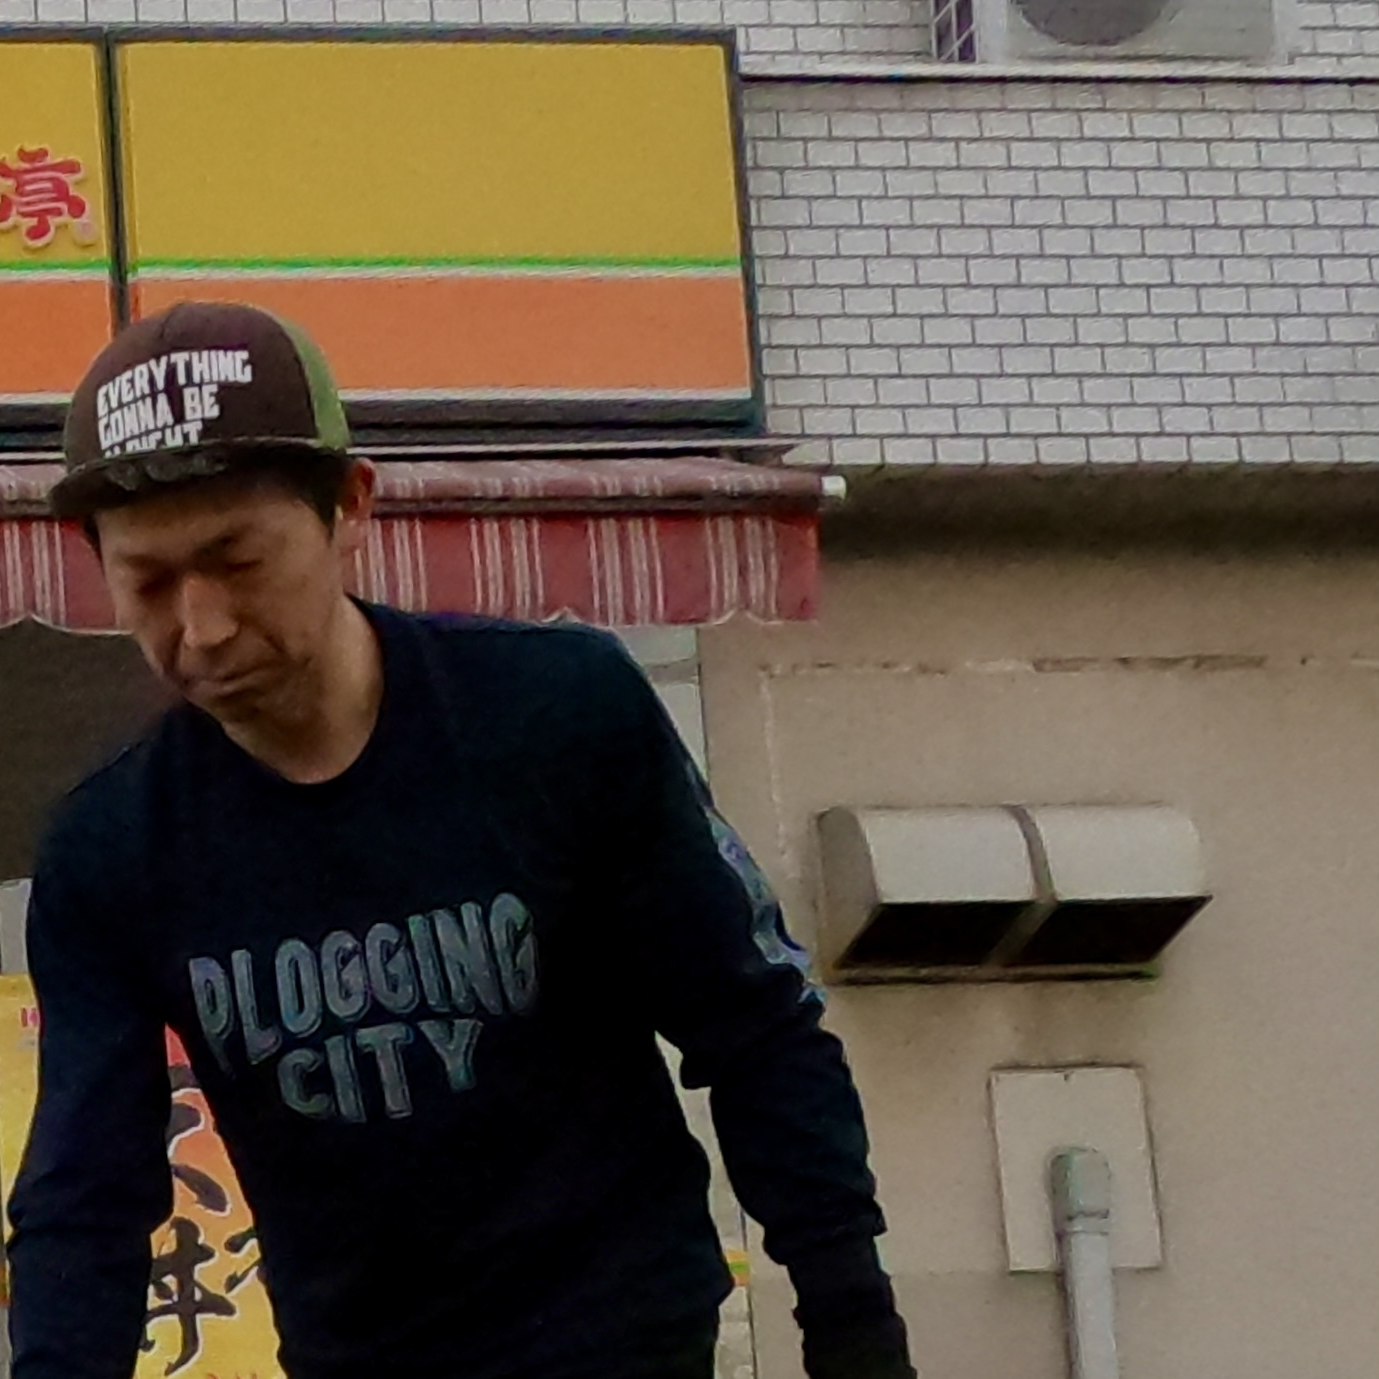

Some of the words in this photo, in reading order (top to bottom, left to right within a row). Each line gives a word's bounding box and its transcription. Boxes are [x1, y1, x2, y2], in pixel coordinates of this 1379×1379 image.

[96, 350, 253, 415] EVERYTHING
[98, 393, 175, 451] GONNA
[182, 384, 220, 421] BE
[188, 891, 538, 1078] PLOGGING
[277, 1015, 483, 1124] CITY
